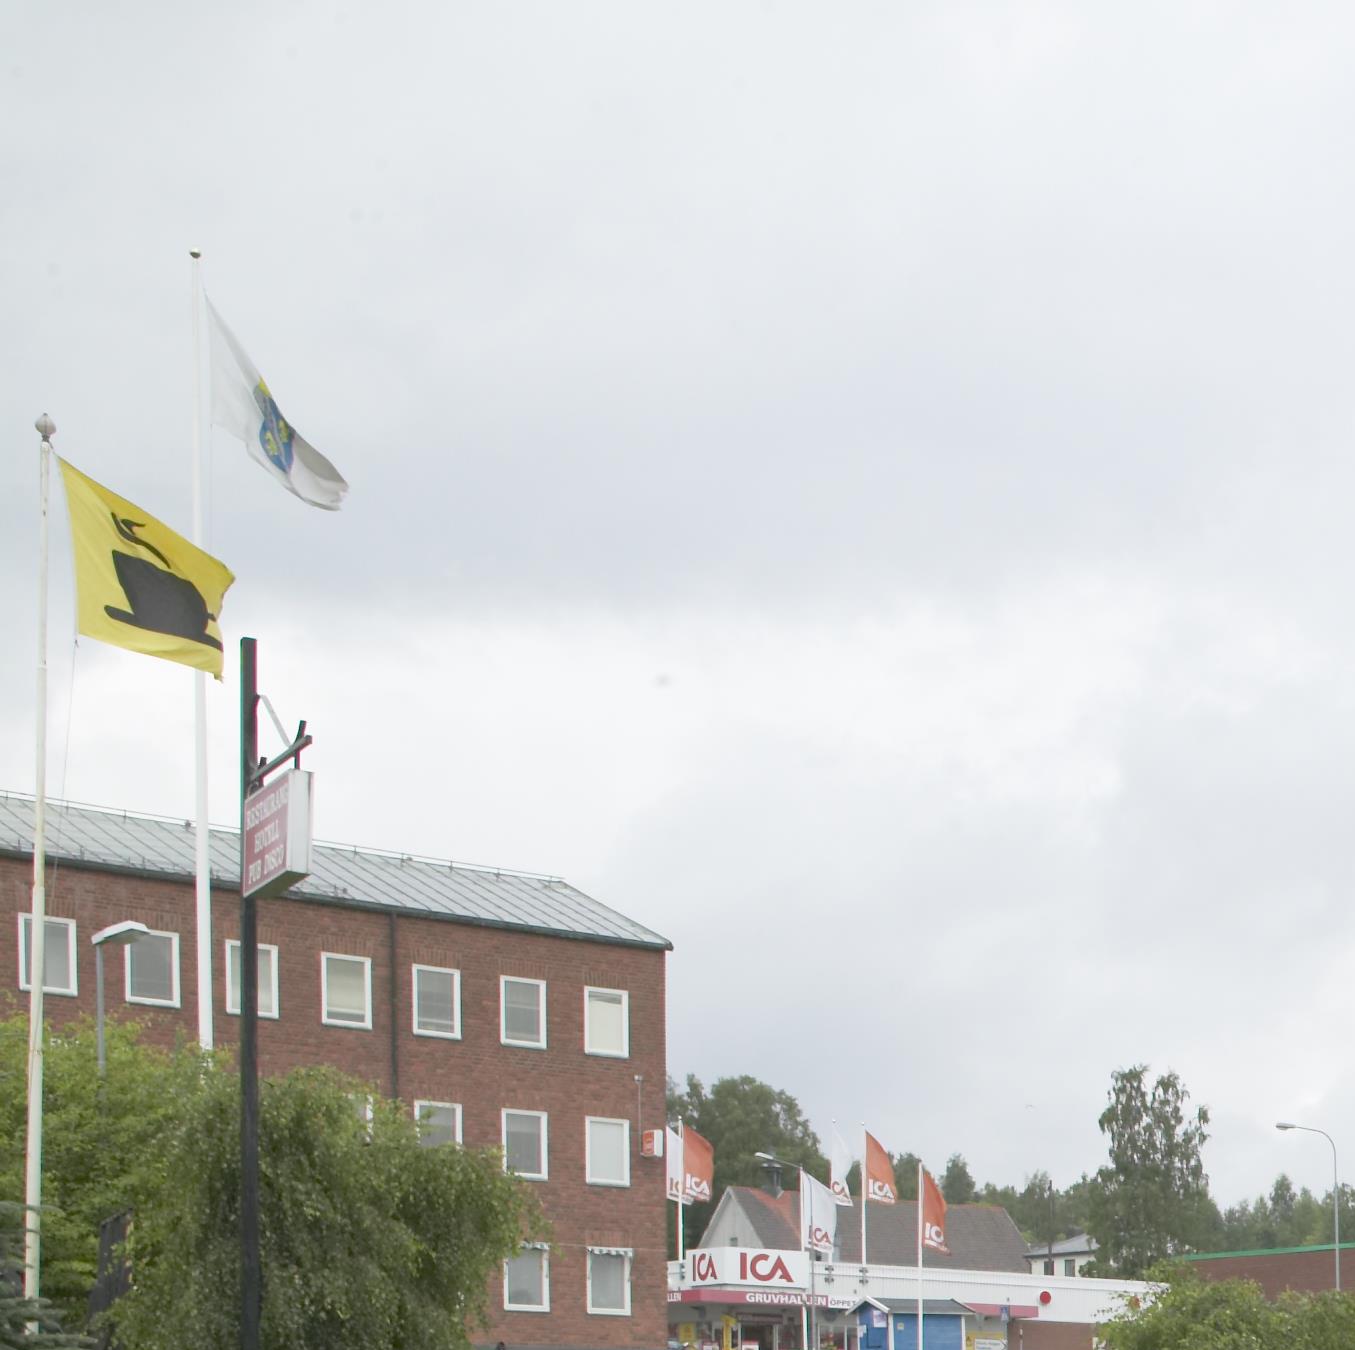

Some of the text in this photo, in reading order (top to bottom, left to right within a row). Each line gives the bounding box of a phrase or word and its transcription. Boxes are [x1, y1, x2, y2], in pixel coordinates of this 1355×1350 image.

[685, 1173, 710, 1196] ICA
[831, 1180, 850, 1199] CA
[868, 1178, 894, 1199] ICA
[808, 1224, 832, 1244] ICA
[692, 1252, 718, 1282] ICA
[739, 1251, 794, 1283] ICA
[745, 1292, 827, 1307] GRUVHALLEN
